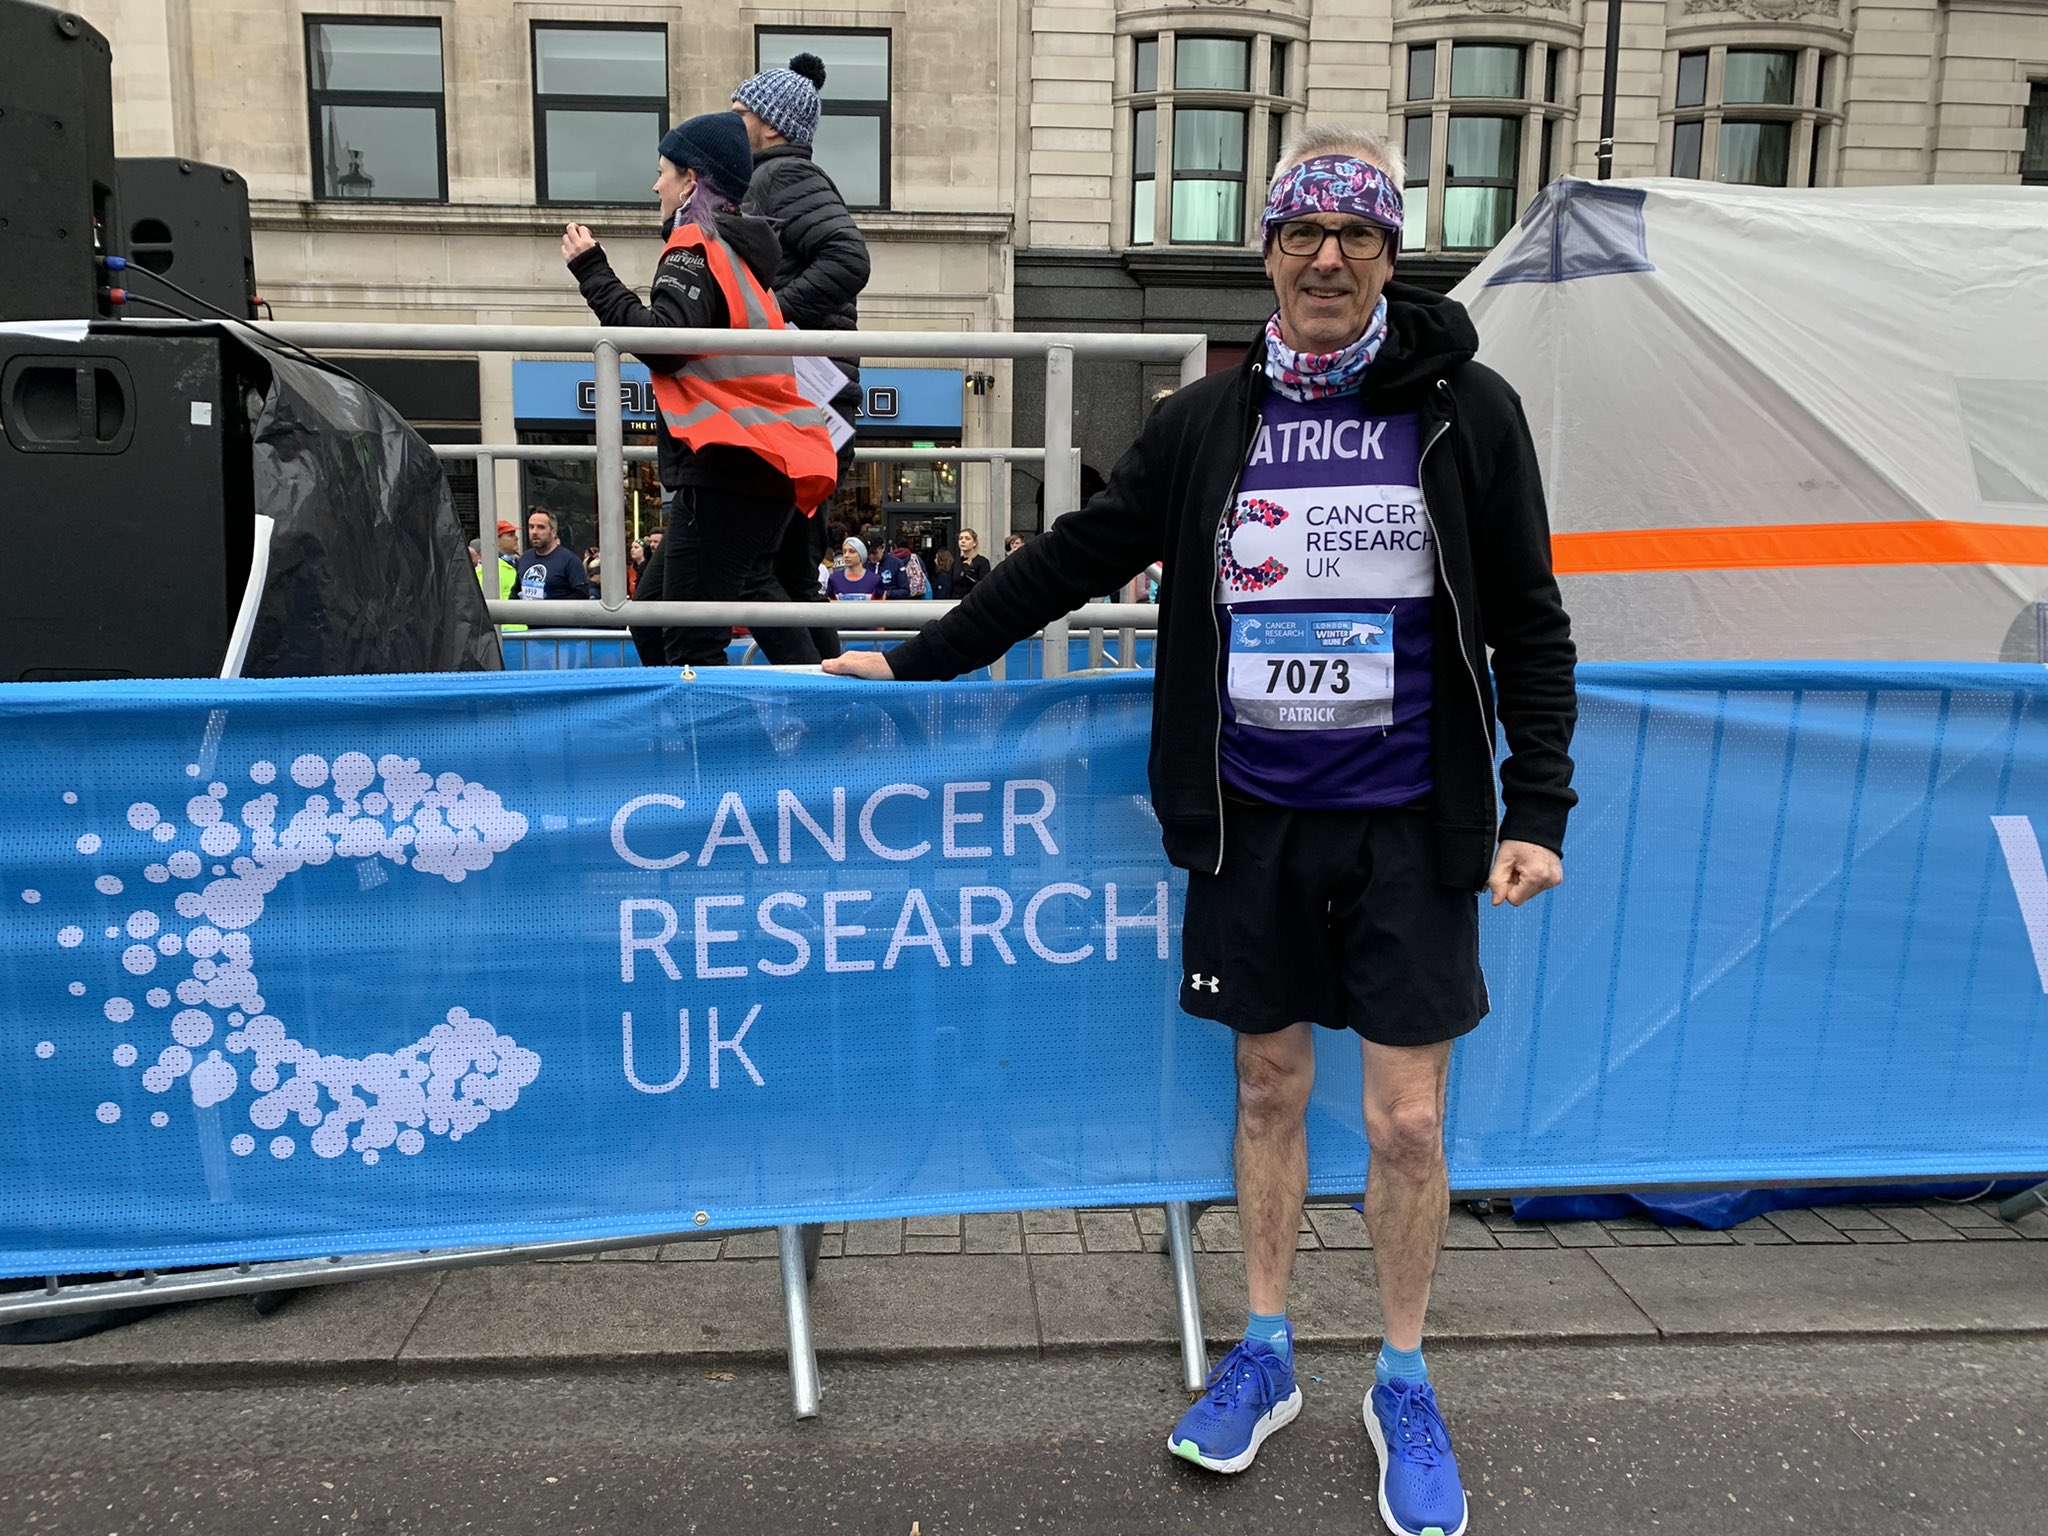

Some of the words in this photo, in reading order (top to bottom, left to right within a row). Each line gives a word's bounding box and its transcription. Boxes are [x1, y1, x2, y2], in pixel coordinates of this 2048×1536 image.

[631, 422, 647, 430] THE
[1249, 419, 1387, 466] ATRICK
[1306, 504, 1416, 526] CANCER
[1307, 530, 1434, 552] RESEARCH
[1306, 557, 1340, 578] UK
[1265, 621, 1296, 629] CANCER
[1315, 621, 1348, 629] LONDON
[1316, 629, 1349, 640] WINTER
[1265, 659, 1350, 694] 7073
[1279, 707, 1335, 722] PATRICK
[610, 779, 1060, 870] CANCER
[619, 881, 1170, 983] RESEARCH
[622, 1004, 766, 1095] UK
